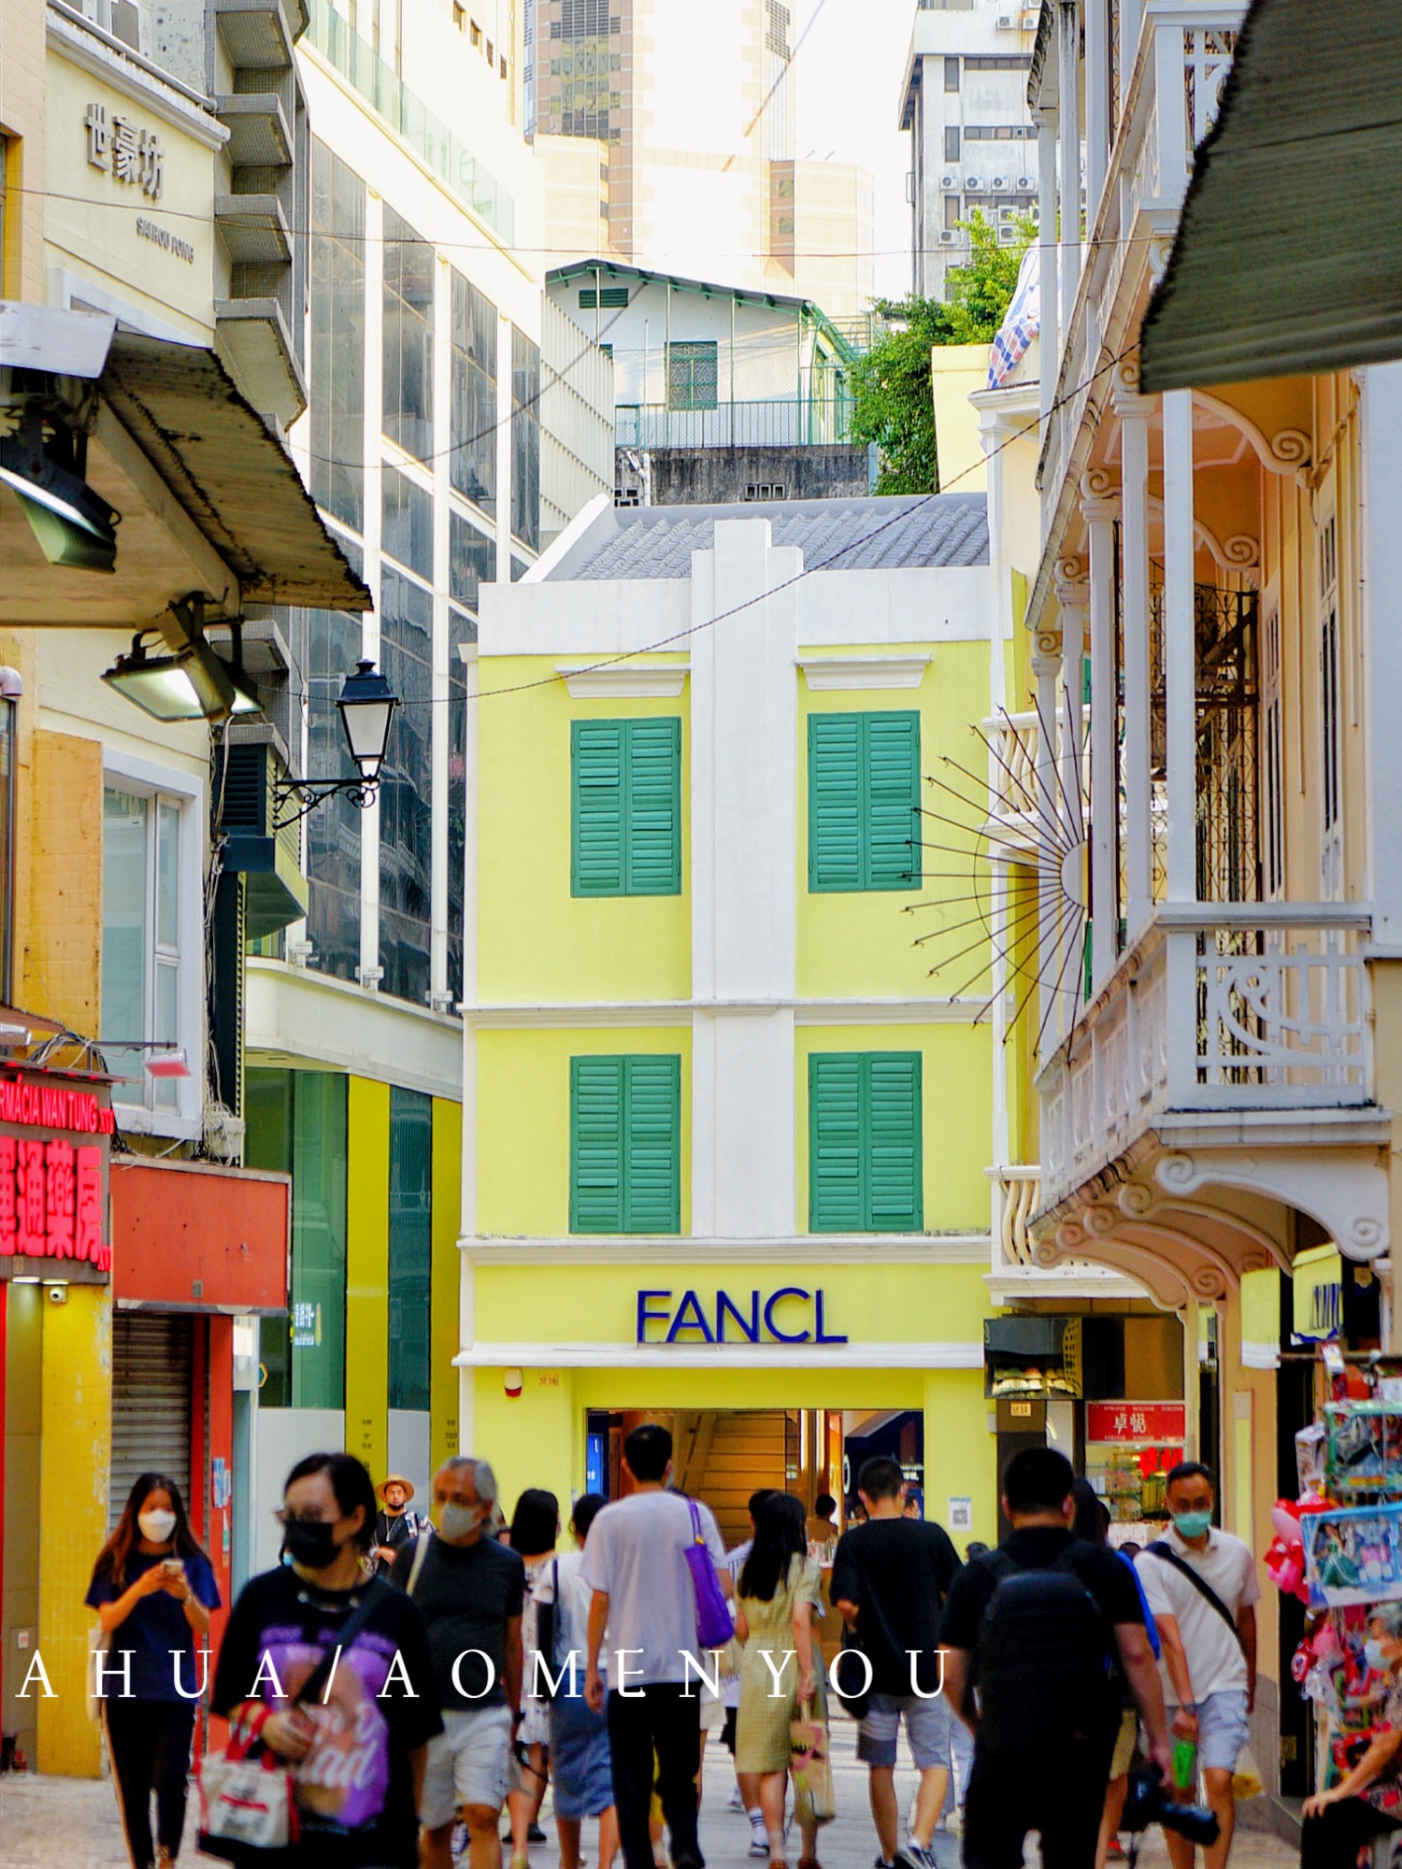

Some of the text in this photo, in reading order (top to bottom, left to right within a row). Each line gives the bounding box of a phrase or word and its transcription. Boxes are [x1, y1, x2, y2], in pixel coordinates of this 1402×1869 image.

[83, 102, 165, 200] 世豪坊
[41, 1087, 68, 1129] WAN
[68, 1091, 98, 1134] TUNG
[637, 1286, 848, 1344] FANCL
